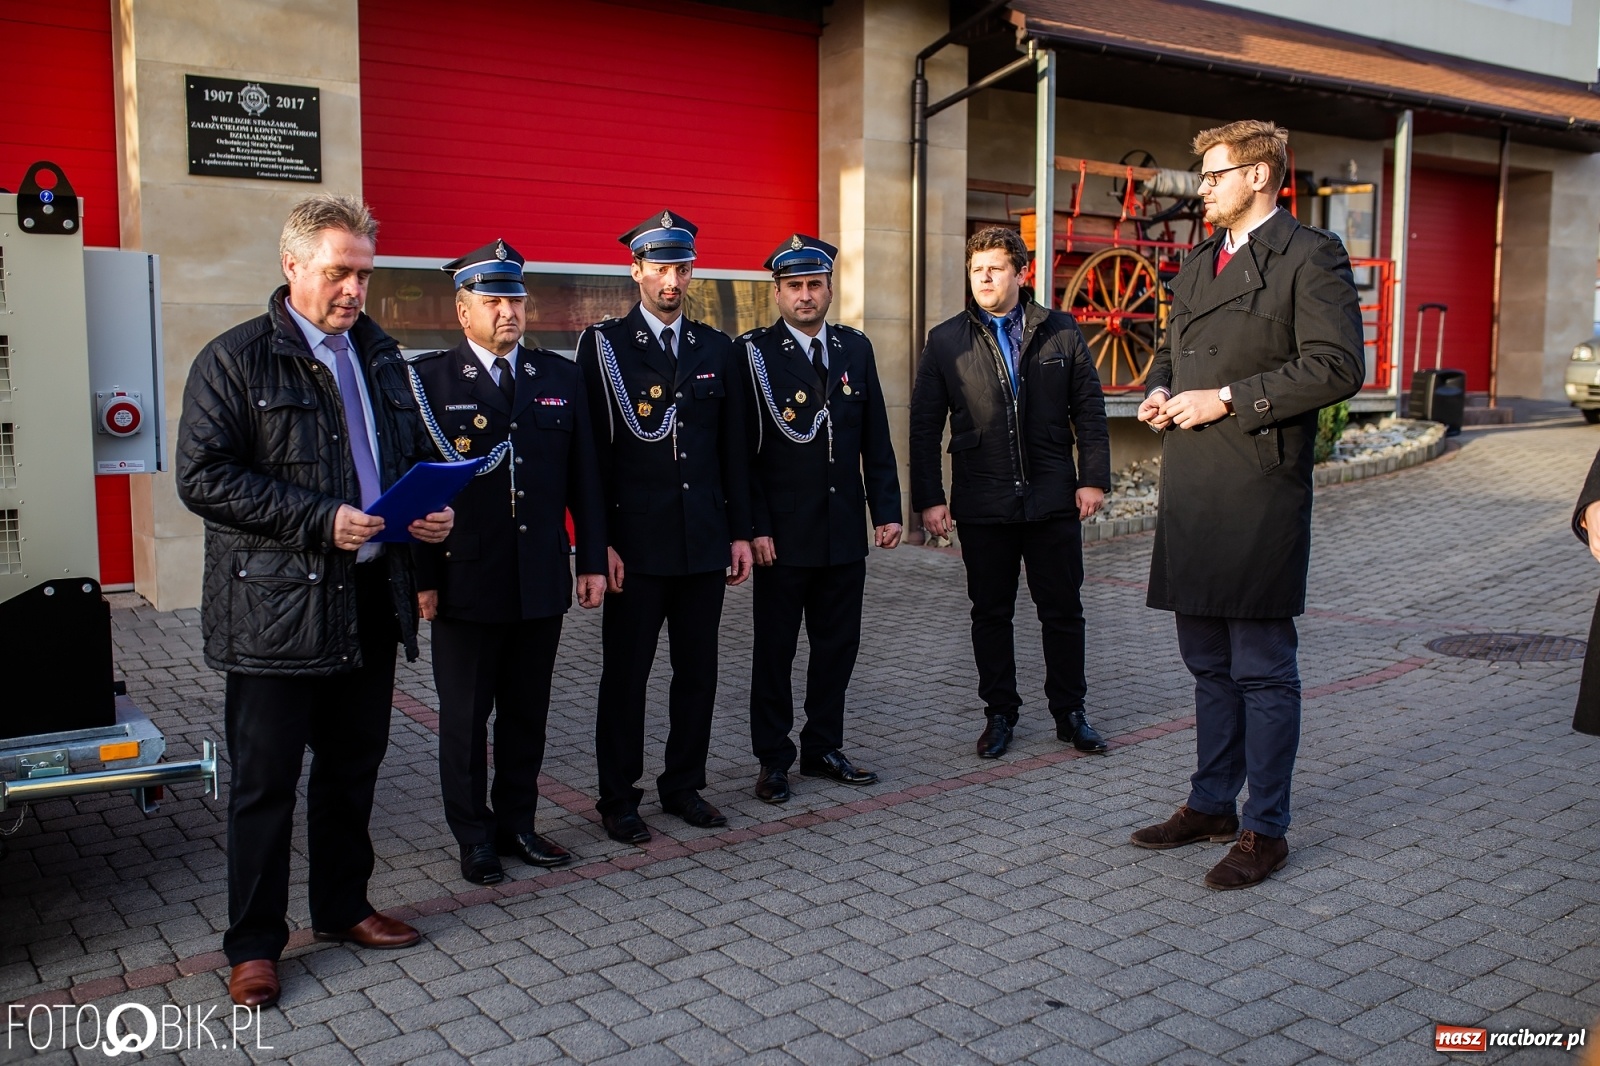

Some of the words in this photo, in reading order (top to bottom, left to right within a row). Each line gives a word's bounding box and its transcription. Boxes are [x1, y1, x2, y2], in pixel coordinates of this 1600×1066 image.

[204, 89, 233, 103] 1907
[276, 96, 305, 110] 2017
[254, 126, 318, 138] KONTYNUATOROM
